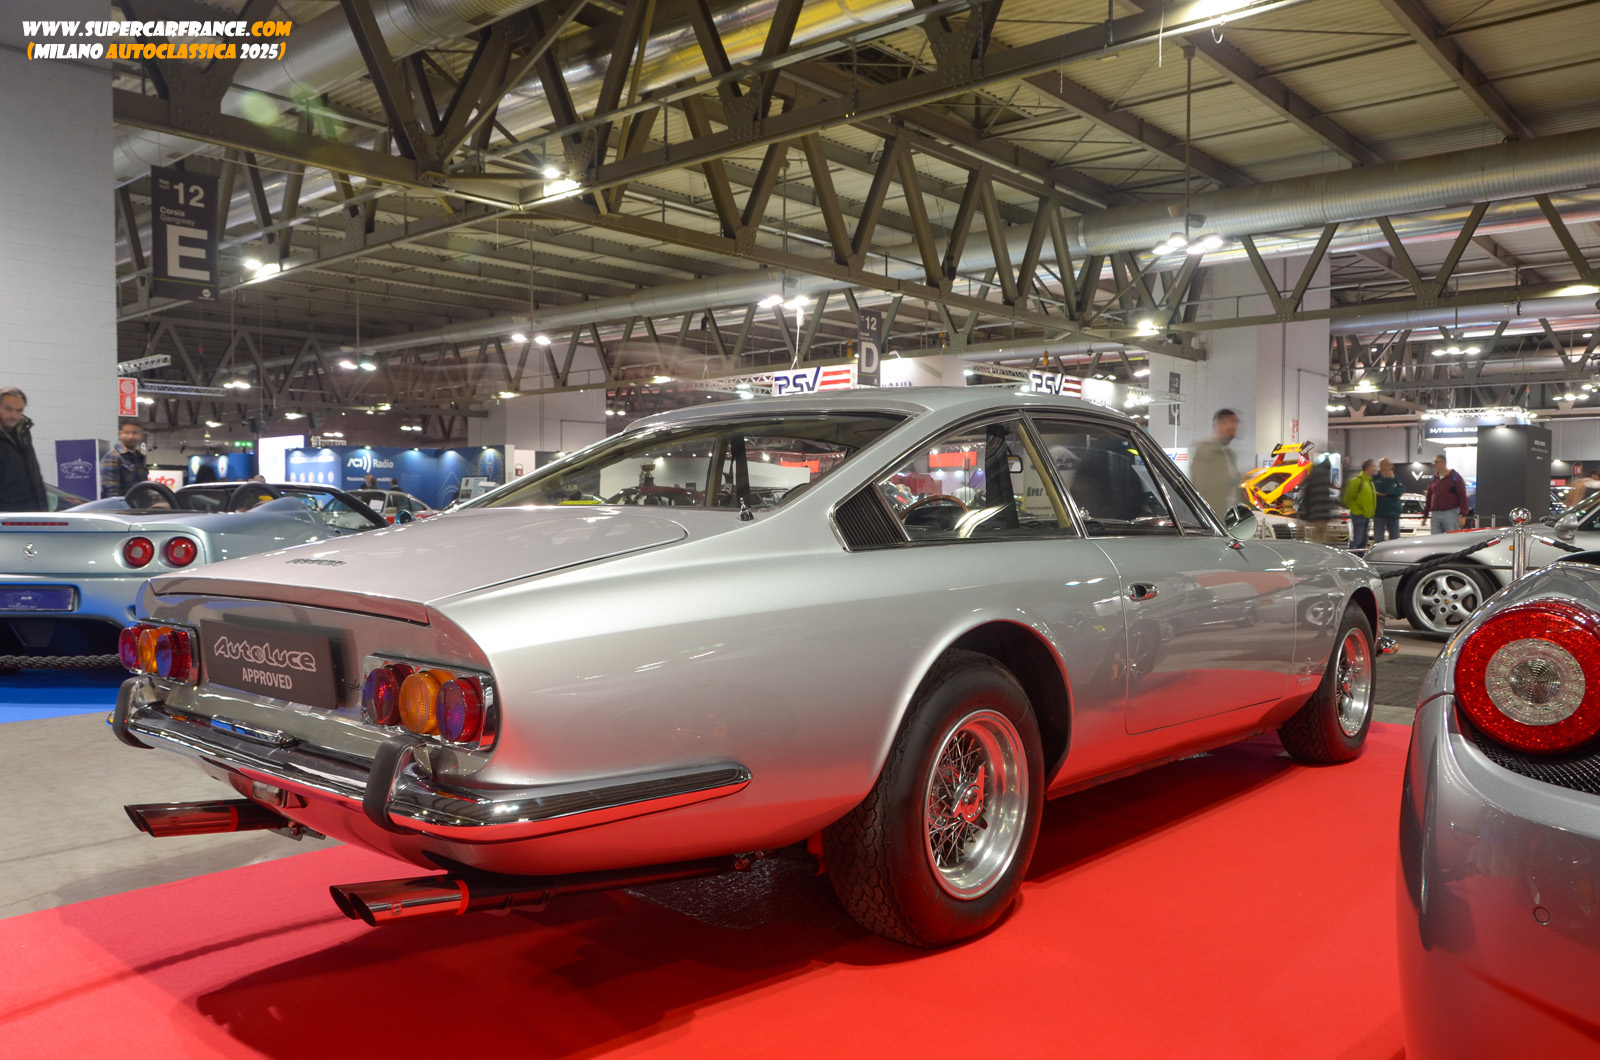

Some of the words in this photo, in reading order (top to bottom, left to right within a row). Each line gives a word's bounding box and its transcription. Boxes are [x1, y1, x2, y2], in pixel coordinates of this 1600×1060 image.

[173, 182, 205, 208] 12
[160, 206, 185, 217] Corsia
[160, 213, 195, 227] Gangway
[166, 224, 210, 281] E
[865, 316, 877, 331] 12
[861, 341, 879, 373] D
[774, 366, 821, 395] PSV
[1032, 373, 1064, 395] PSV
[373, 459, 394, 468] Radio
[1026, 486, 1044, 497] Ever
[242, 667, 293, 690] APPROVED
